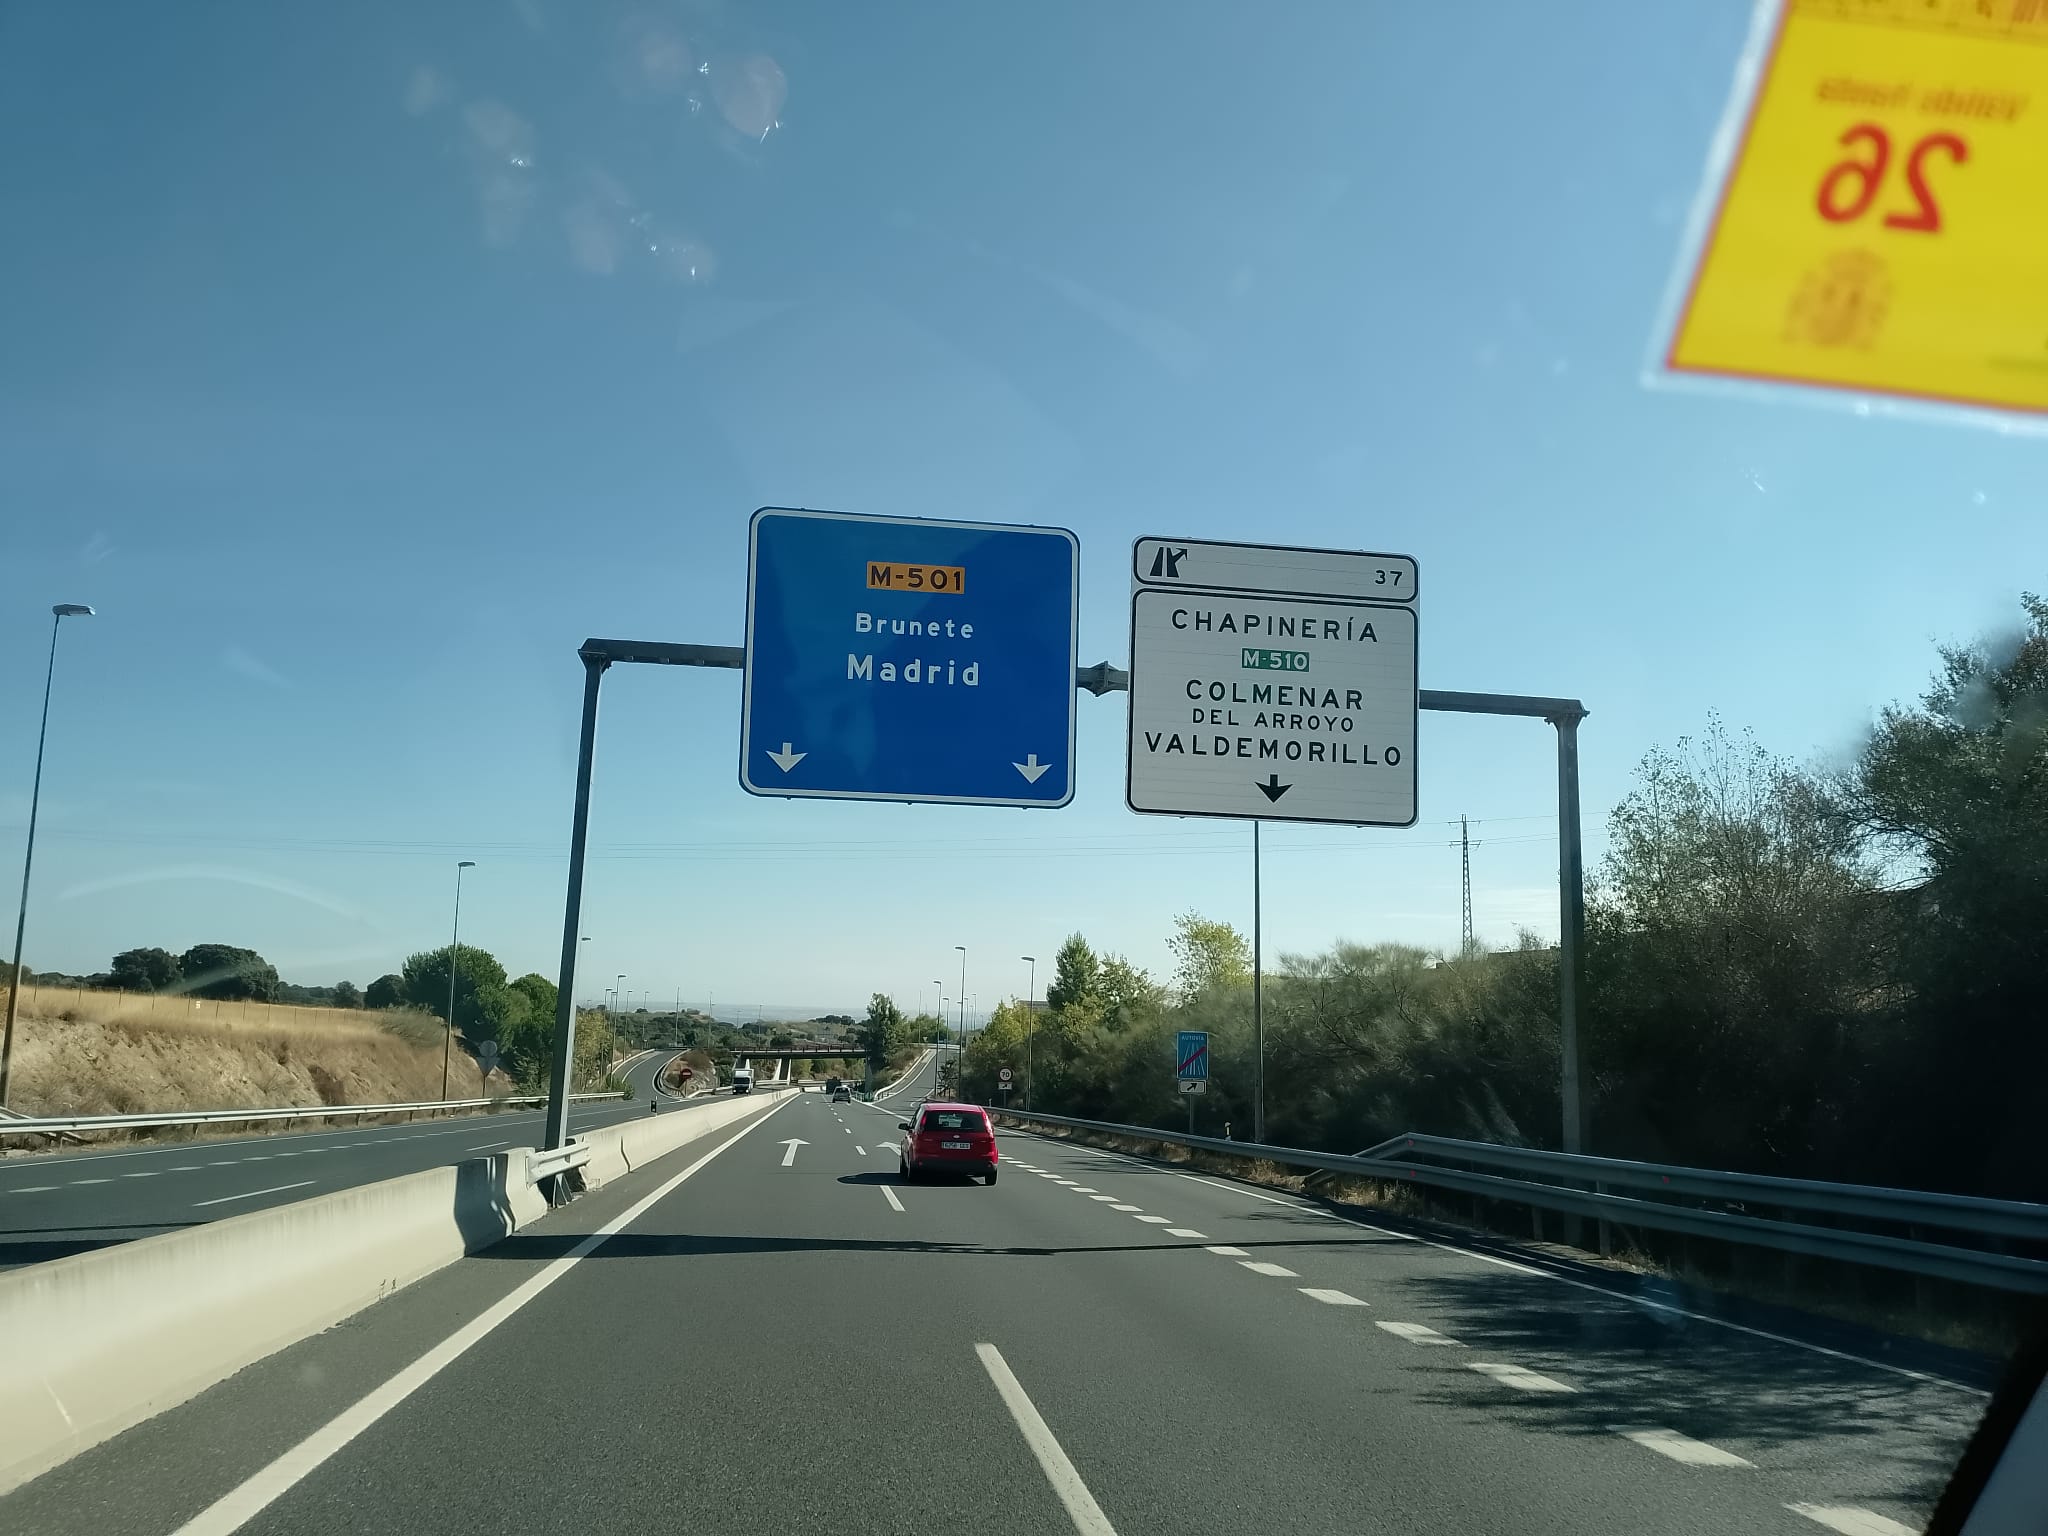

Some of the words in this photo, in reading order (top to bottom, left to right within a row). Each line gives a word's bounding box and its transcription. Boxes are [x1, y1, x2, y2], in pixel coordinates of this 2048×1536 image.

[870, 565, 962, 591] M-501
[1374, 569, 1403, 587] 37
[855, 612, 974, 638] Brunete
[1171, 608, 1378, 643] CHAPINERÍA
[847, 653, 980, 687] Madrid
[1243, 650, 1309, 671] M-510
[1186, 679, 1363, 711] COLMENAR
[1192, 708, 1239, 726] DEL
[1254, 712, 1354, 733] ARROYO
[1144, 731, 1401, 767] VALDEMORILLO
